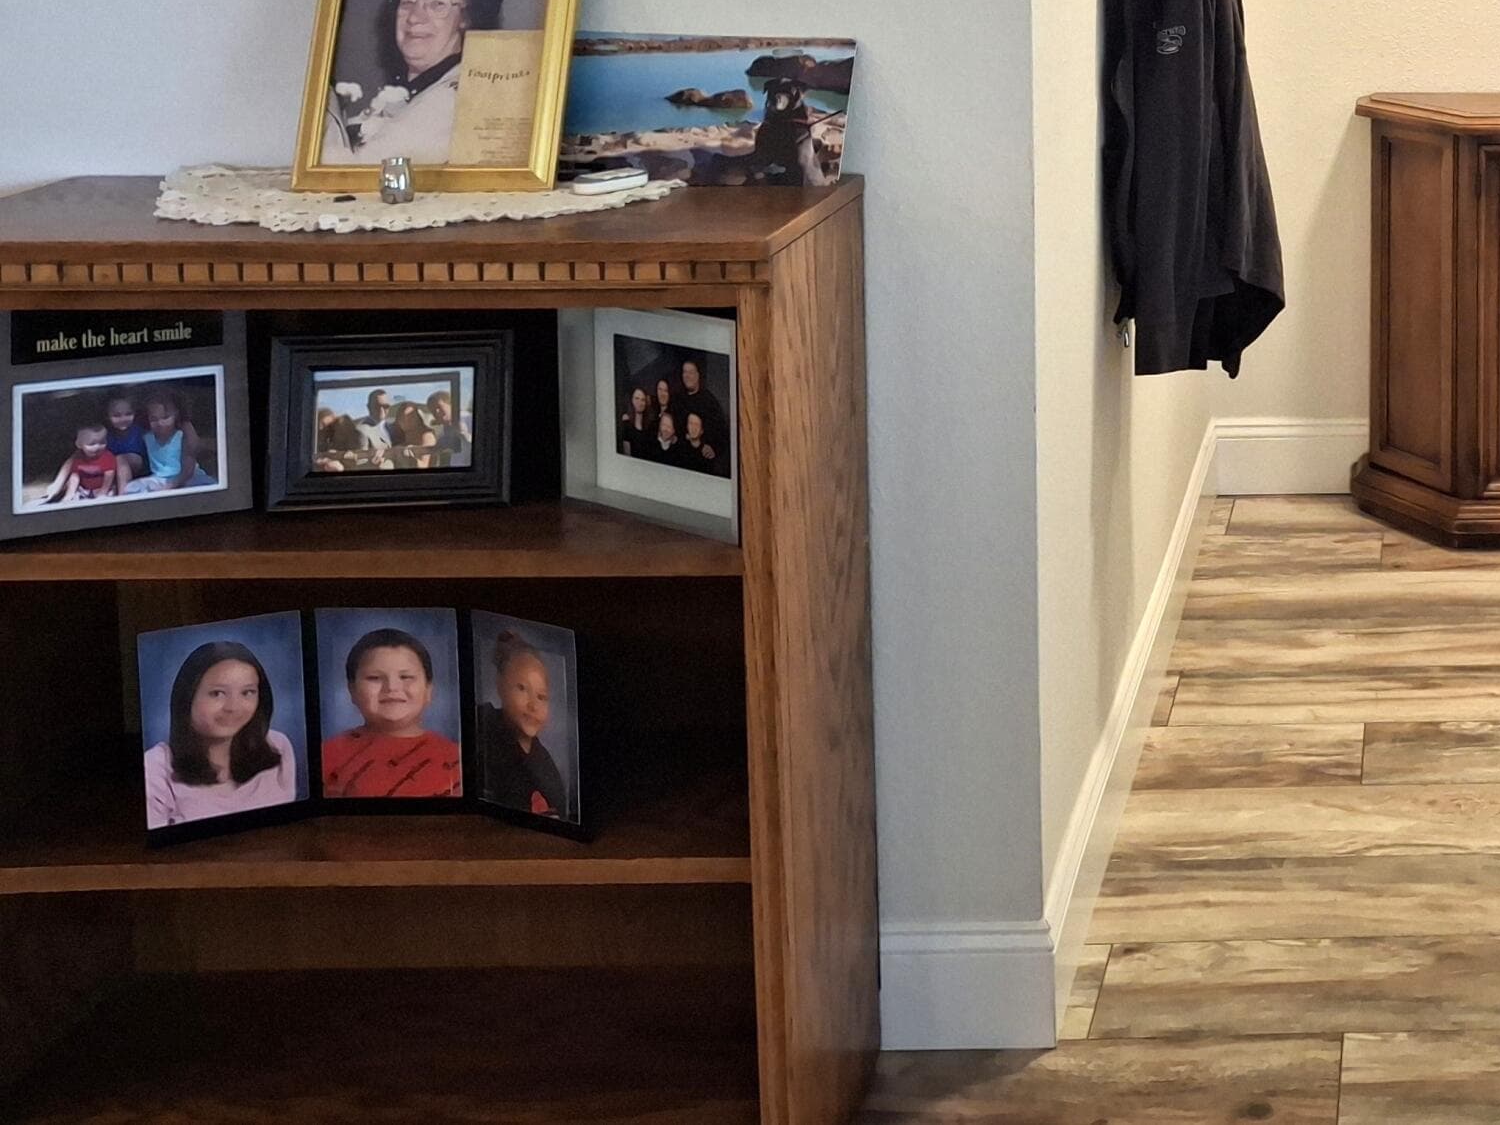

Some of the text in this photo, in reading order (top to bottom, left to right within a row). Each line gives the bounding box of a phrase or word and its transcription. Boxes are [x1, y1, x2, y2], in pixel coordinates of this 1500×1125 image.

[36, 321, 193, 353] make the heart smile
